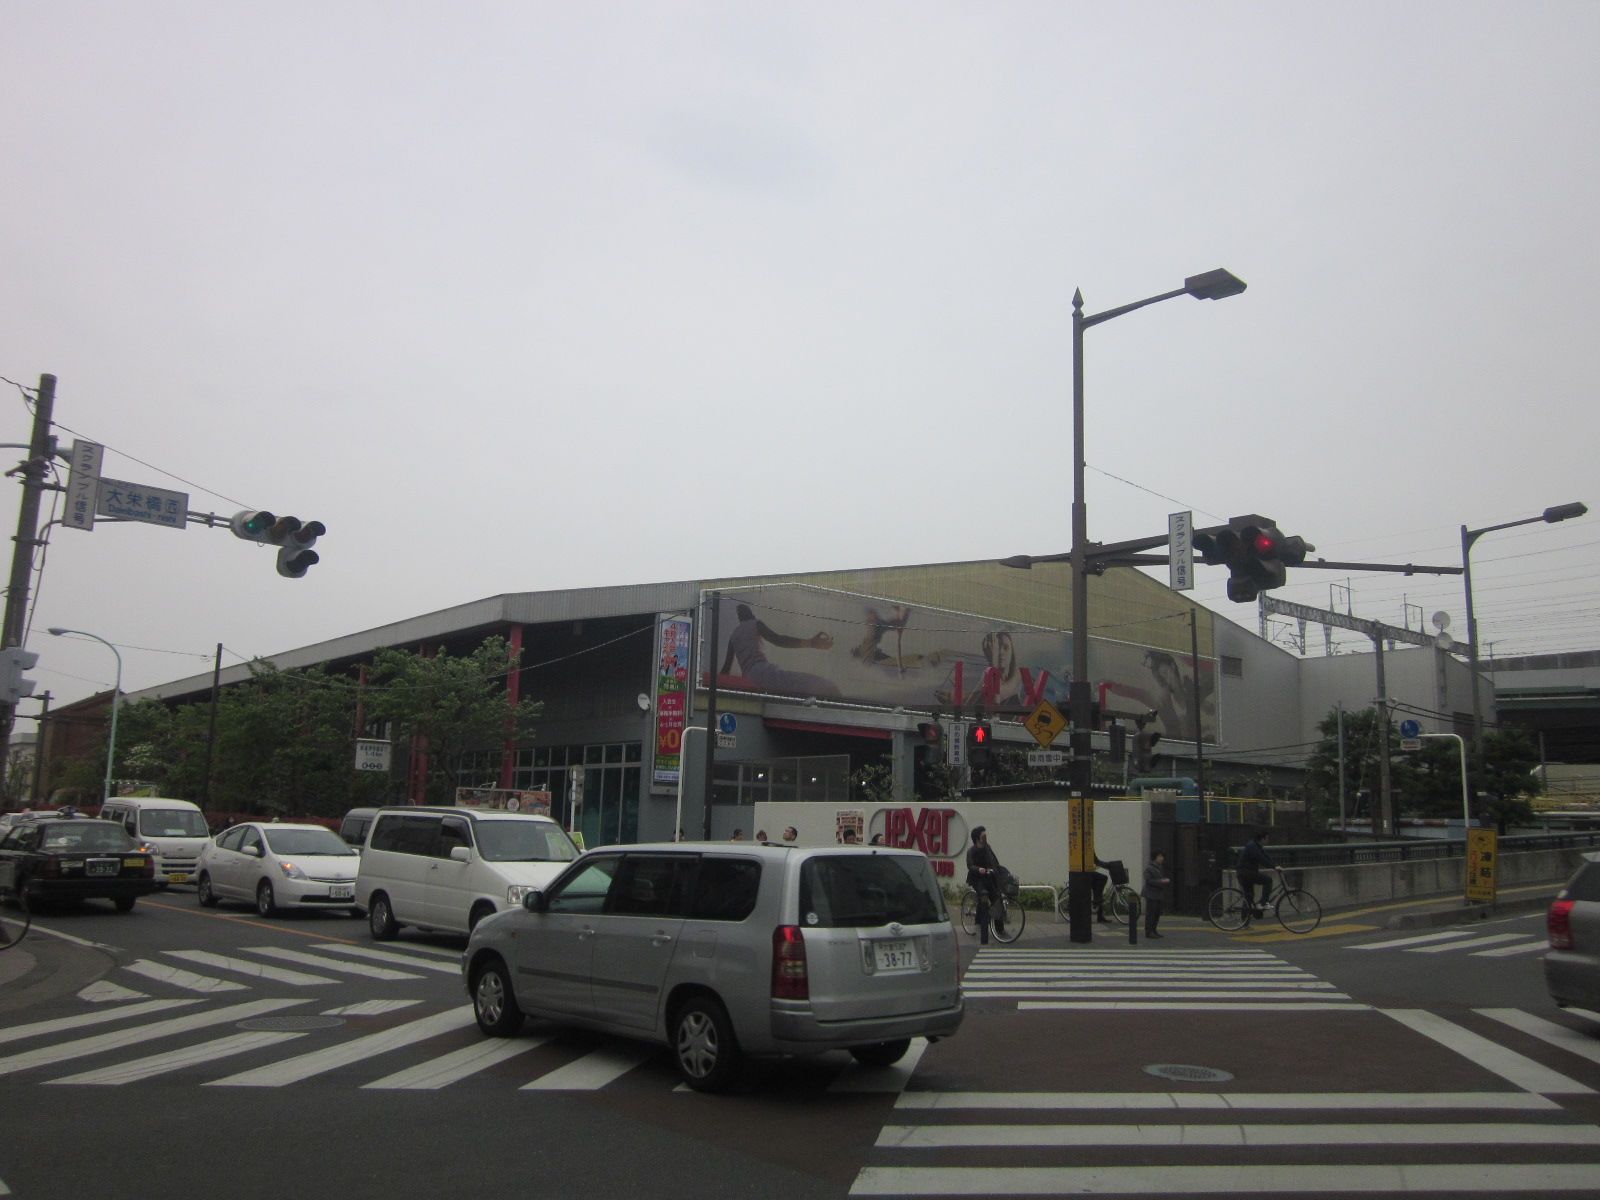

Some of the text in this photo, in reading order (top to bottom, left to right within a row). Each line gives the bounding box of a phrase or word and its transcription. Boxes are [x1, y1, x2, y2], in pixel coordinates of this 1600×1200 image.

[73, 444, 96, 525] スクランブル信号
[105, 488, 180, 515] 大栄橋西
[1175, 515, 1186, 587] スクランブル信号
[883, 951, 912, 967] 38-77
